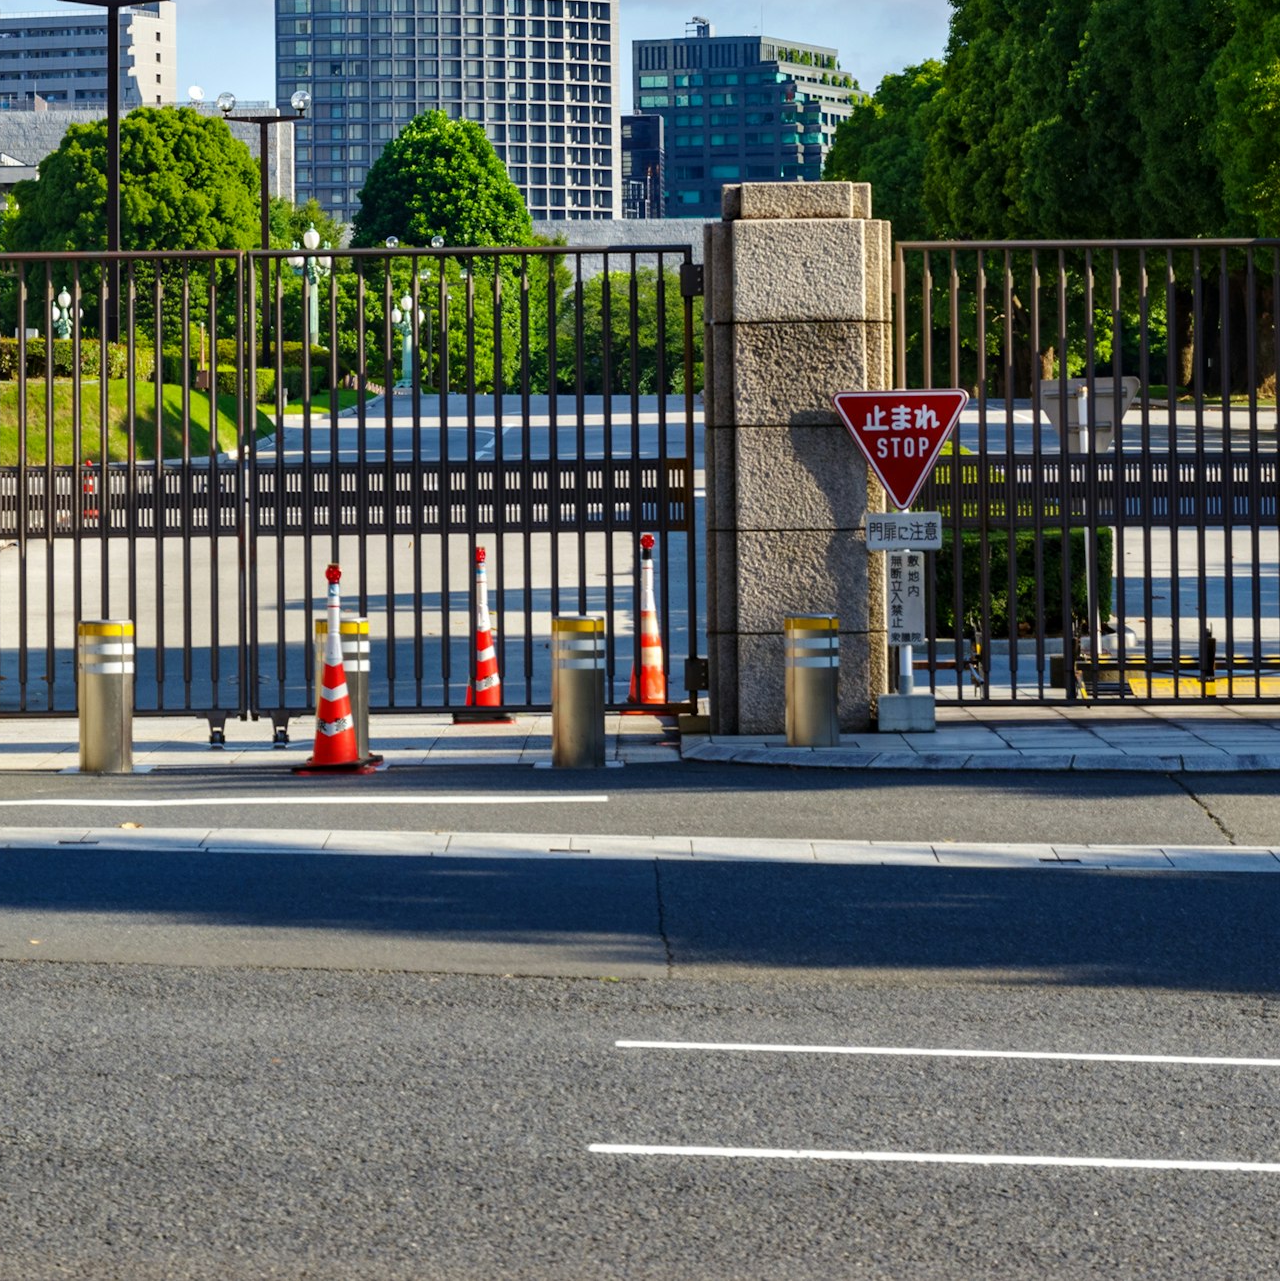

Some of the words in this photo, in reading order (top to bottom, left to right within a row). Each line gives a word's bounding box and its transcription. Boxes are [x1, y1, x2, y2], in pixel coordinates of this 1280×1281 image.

[862, 404, 941, 431] 止まれ
[876, 437, 930, 458] STOP
[869, 521, 938, 542] 門扉に注意
[907, 555, 920, 598] 敷地内
[890, 555, 904, 629] 無断立入禁止
[890, 632, 921, 643] 衆議院
